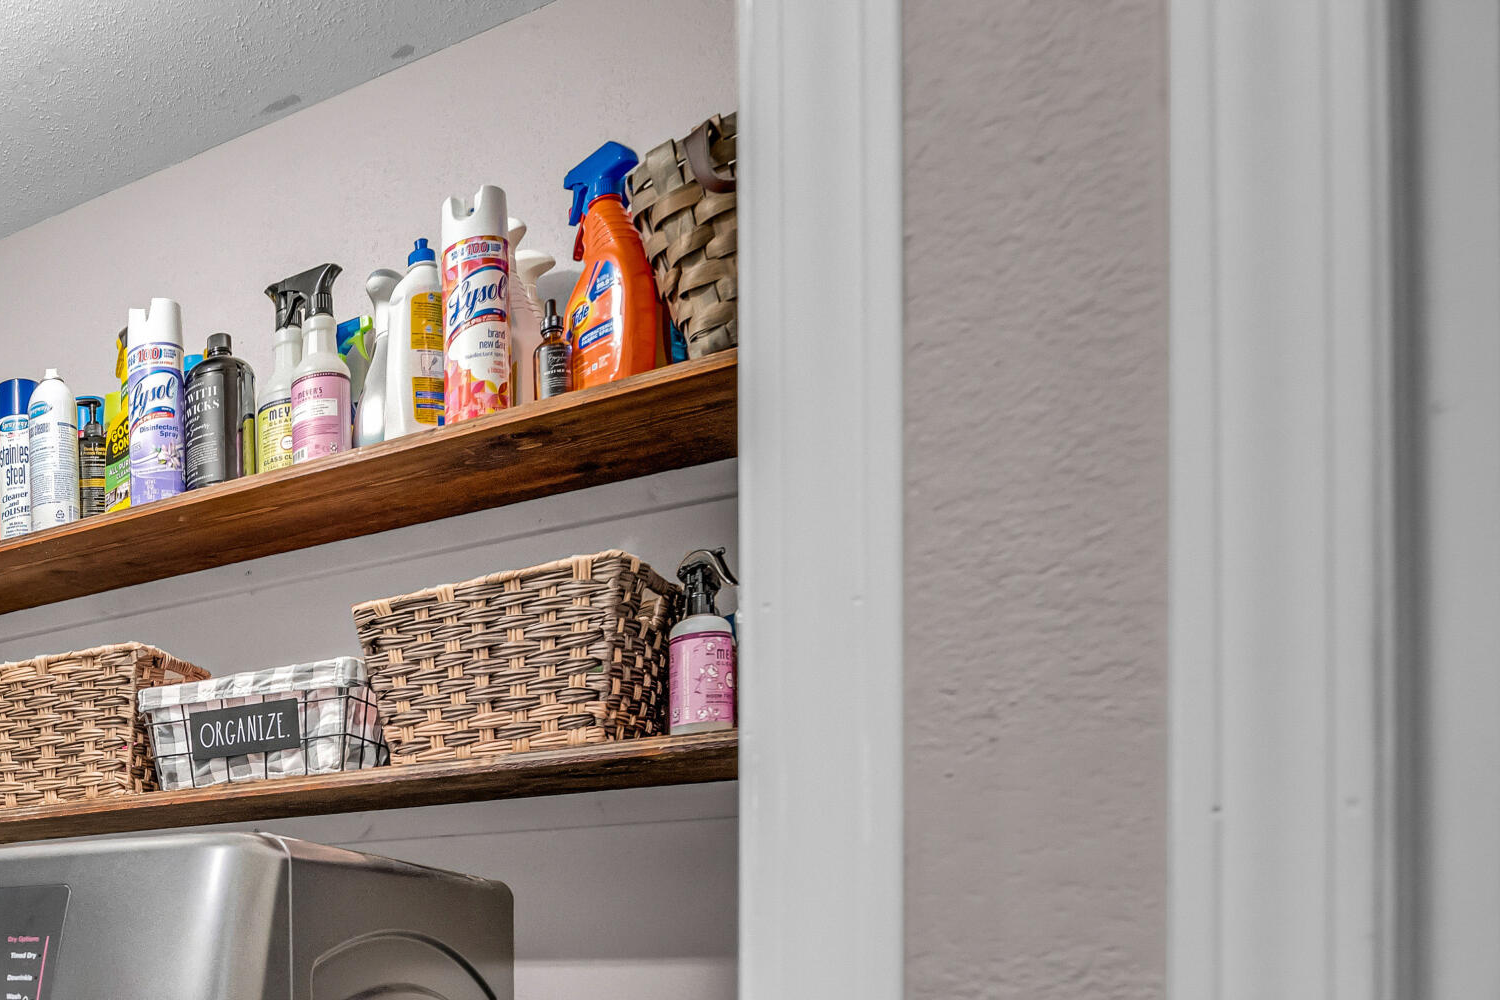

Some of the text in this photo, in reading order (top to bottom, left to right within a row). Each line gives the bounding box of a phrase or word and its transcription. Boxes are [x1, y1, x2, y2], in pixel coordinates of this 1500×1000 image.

[449, 275, 507, 326] Lysol
[572, 303, 590, 327] Tide
[130, 376, 175, 420] Lysol
[187, 386, 217, 404] WITH
[0, 444, 29, 468] stainles
[112, 434, 130, 454] GON
[6, 464, 26, 486] steel
[200, 712, 291, 748] ORGANIZE.
